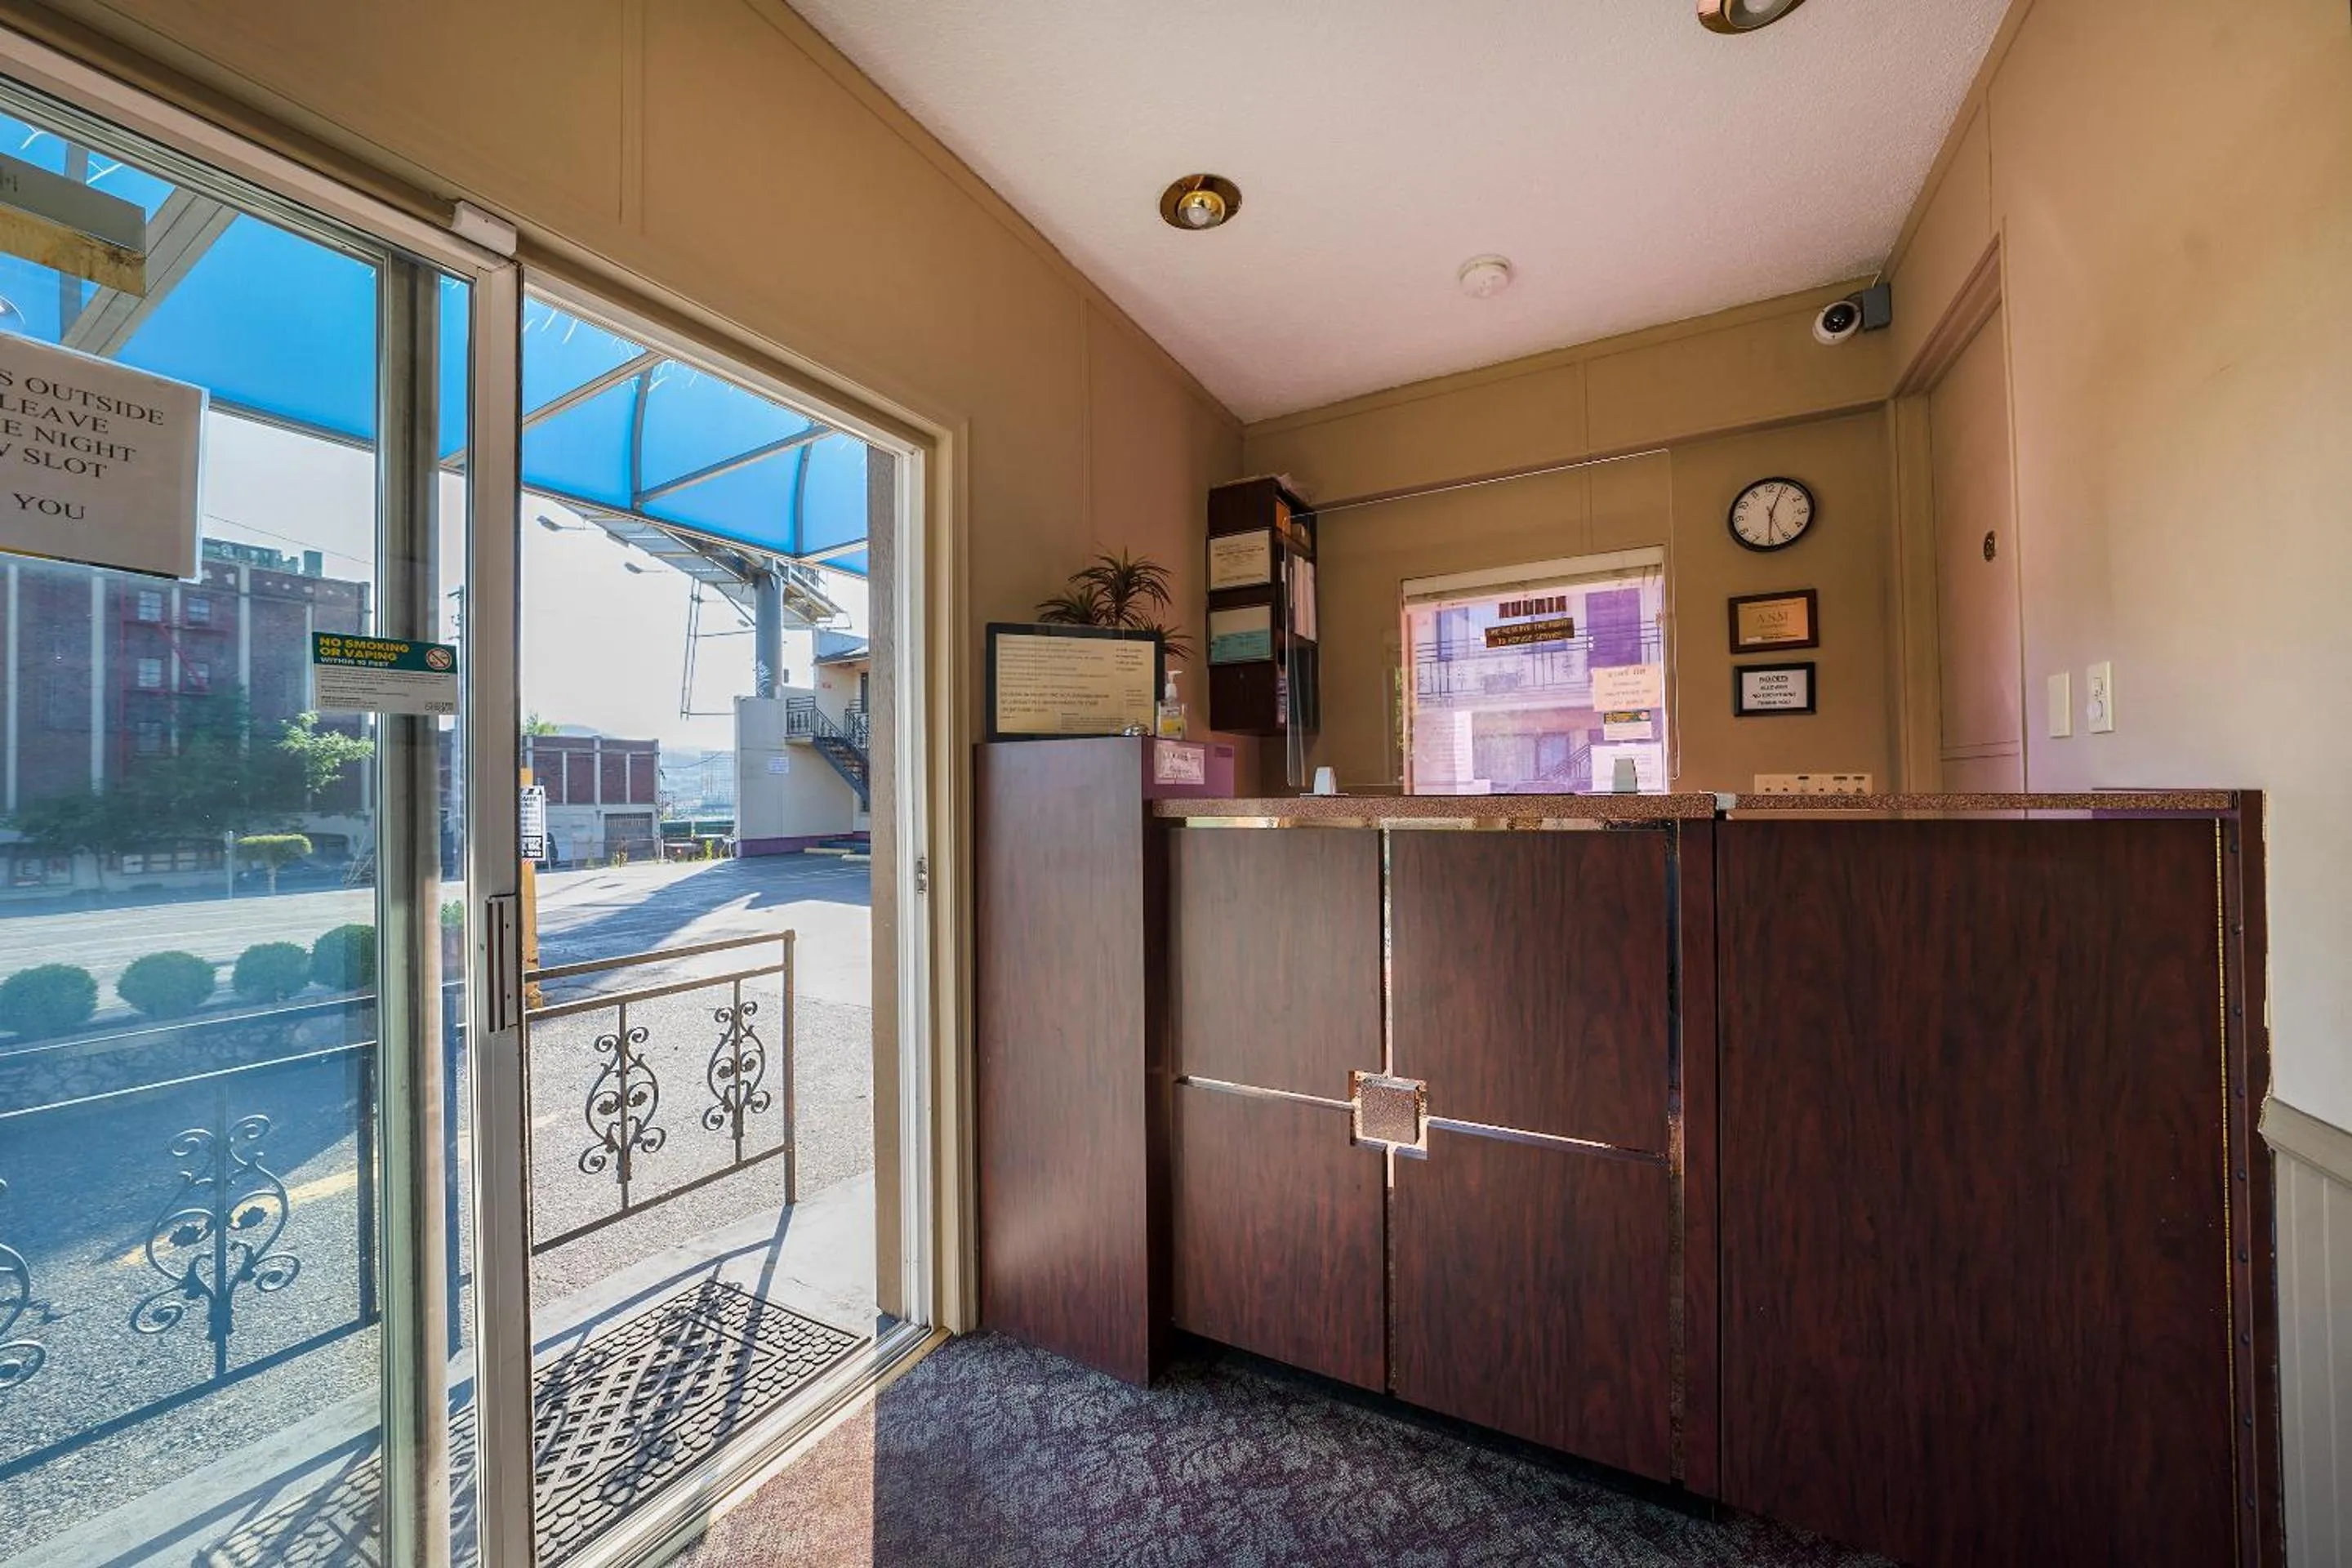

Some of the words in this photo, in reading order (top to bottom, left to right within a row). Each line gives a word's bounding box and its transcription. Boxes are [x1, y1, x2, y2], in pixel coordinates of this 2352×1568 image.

[0, 394, 109, 434] LEAVE
[25, 377, 164, 425] OUTSIDE
[34, 425, 136, 462] NIGHT
[23, 448, 107, 479] SLOT
[1765, 484, 1775, 493] 12
[13, 492, 85, 520] YOU
[319, 636, 341, 647] NO
[345, 639, 410, 653] SMOKING
[319, 647, 341, 657] OR
[344, 648, 397, 661] VAPING
[320, 657, 354, 666] WITHIN
